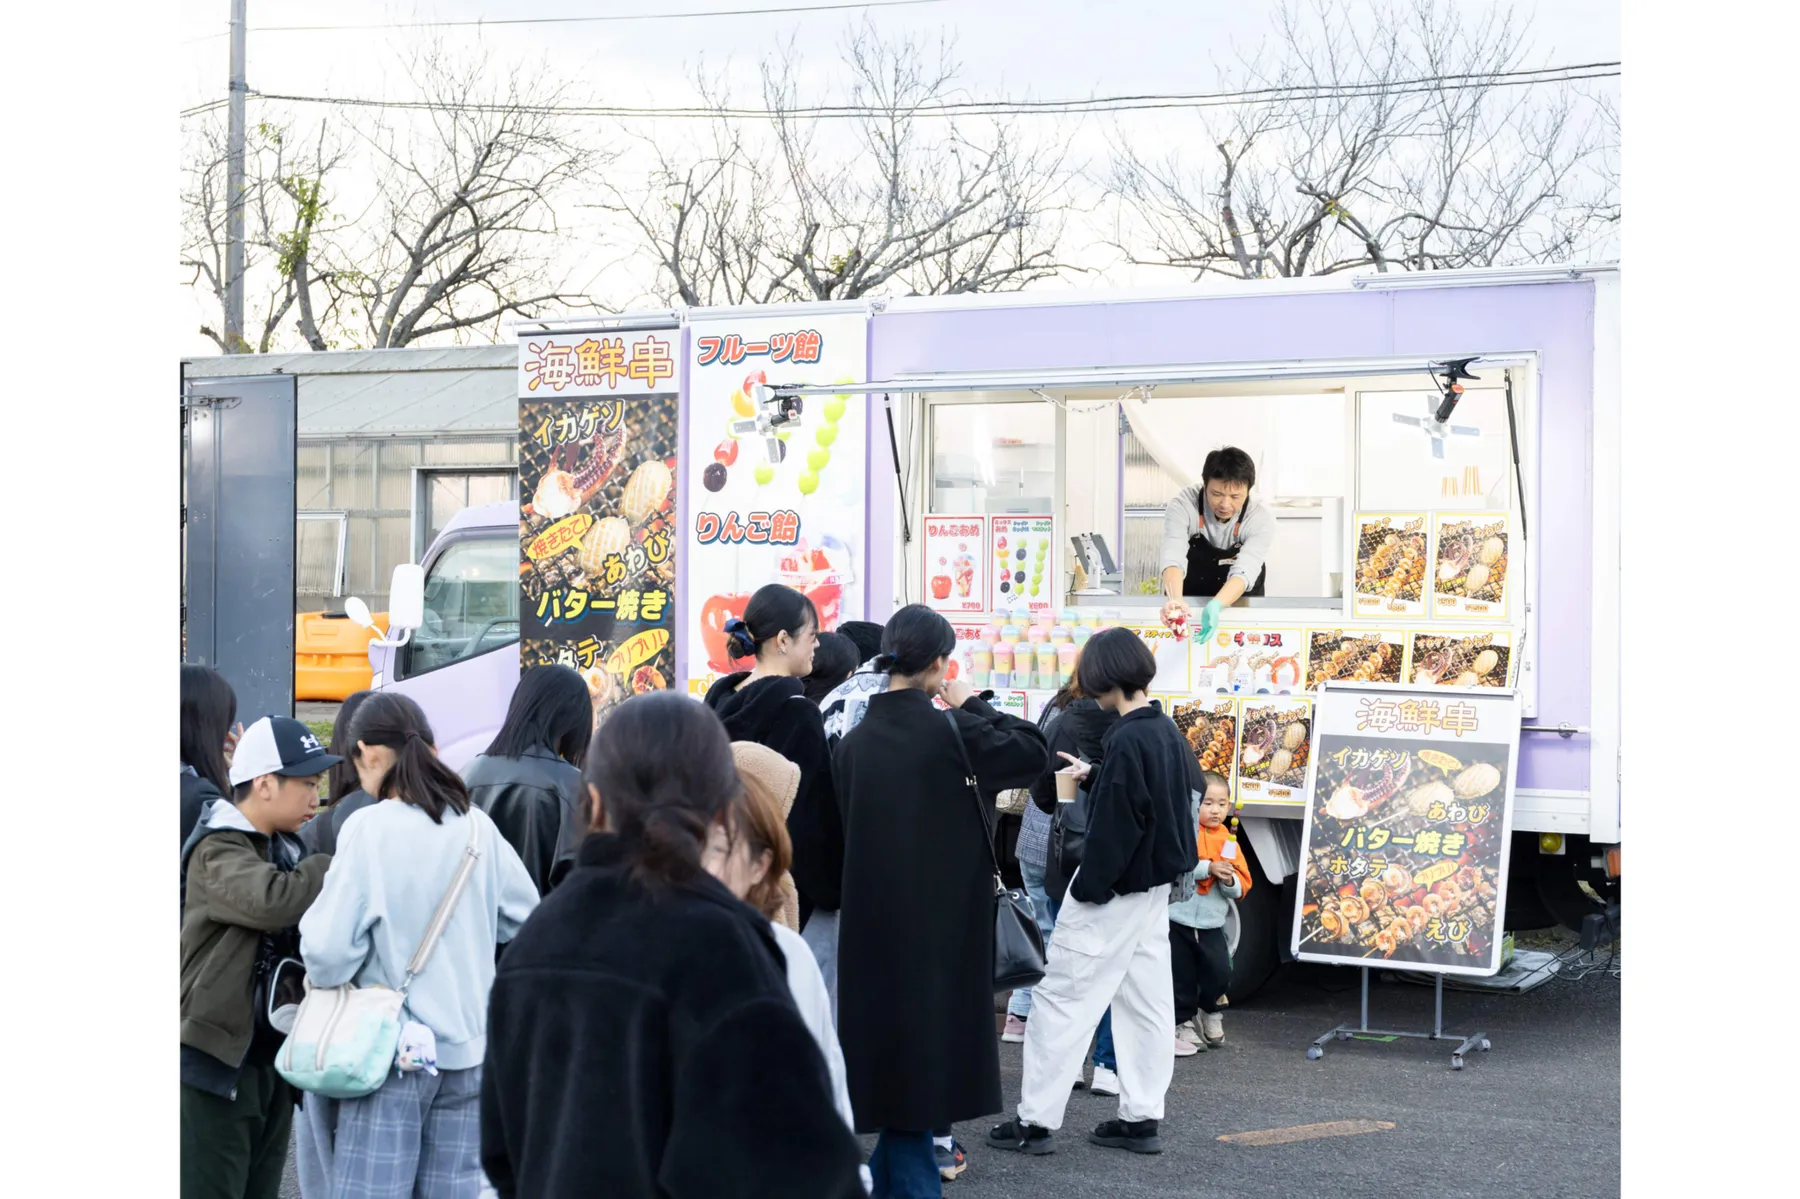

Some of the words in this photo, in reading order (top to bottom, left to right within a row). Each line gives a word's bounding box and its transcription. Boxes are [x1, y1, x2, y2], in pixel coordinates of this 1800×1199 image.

[525, 335, 673, 391] 海鮮串
[697, 330, 823, 366] フルーツ飴
[532, 398, 626, 448] イカゲソ
[532, 514, 590, 558] 焼きたて!
[695, 510, 801, 545] りんご飴
[928, 524, 980, 537] りんごあめ
[603, 528, 671, 587] あわび
[536, 588, 670, 625] バター焼き
[1356, 698, 1478, 737] 海鮮串
[1332, 745, 1410, 771] イカゲソ
[1427, 801, 1490, 824] あわび
[1340, 827, 1467, 857] バター焼き
[1329, 855, 1389, 878] ホタテ
[1425, 918, 1472, 942] えび
